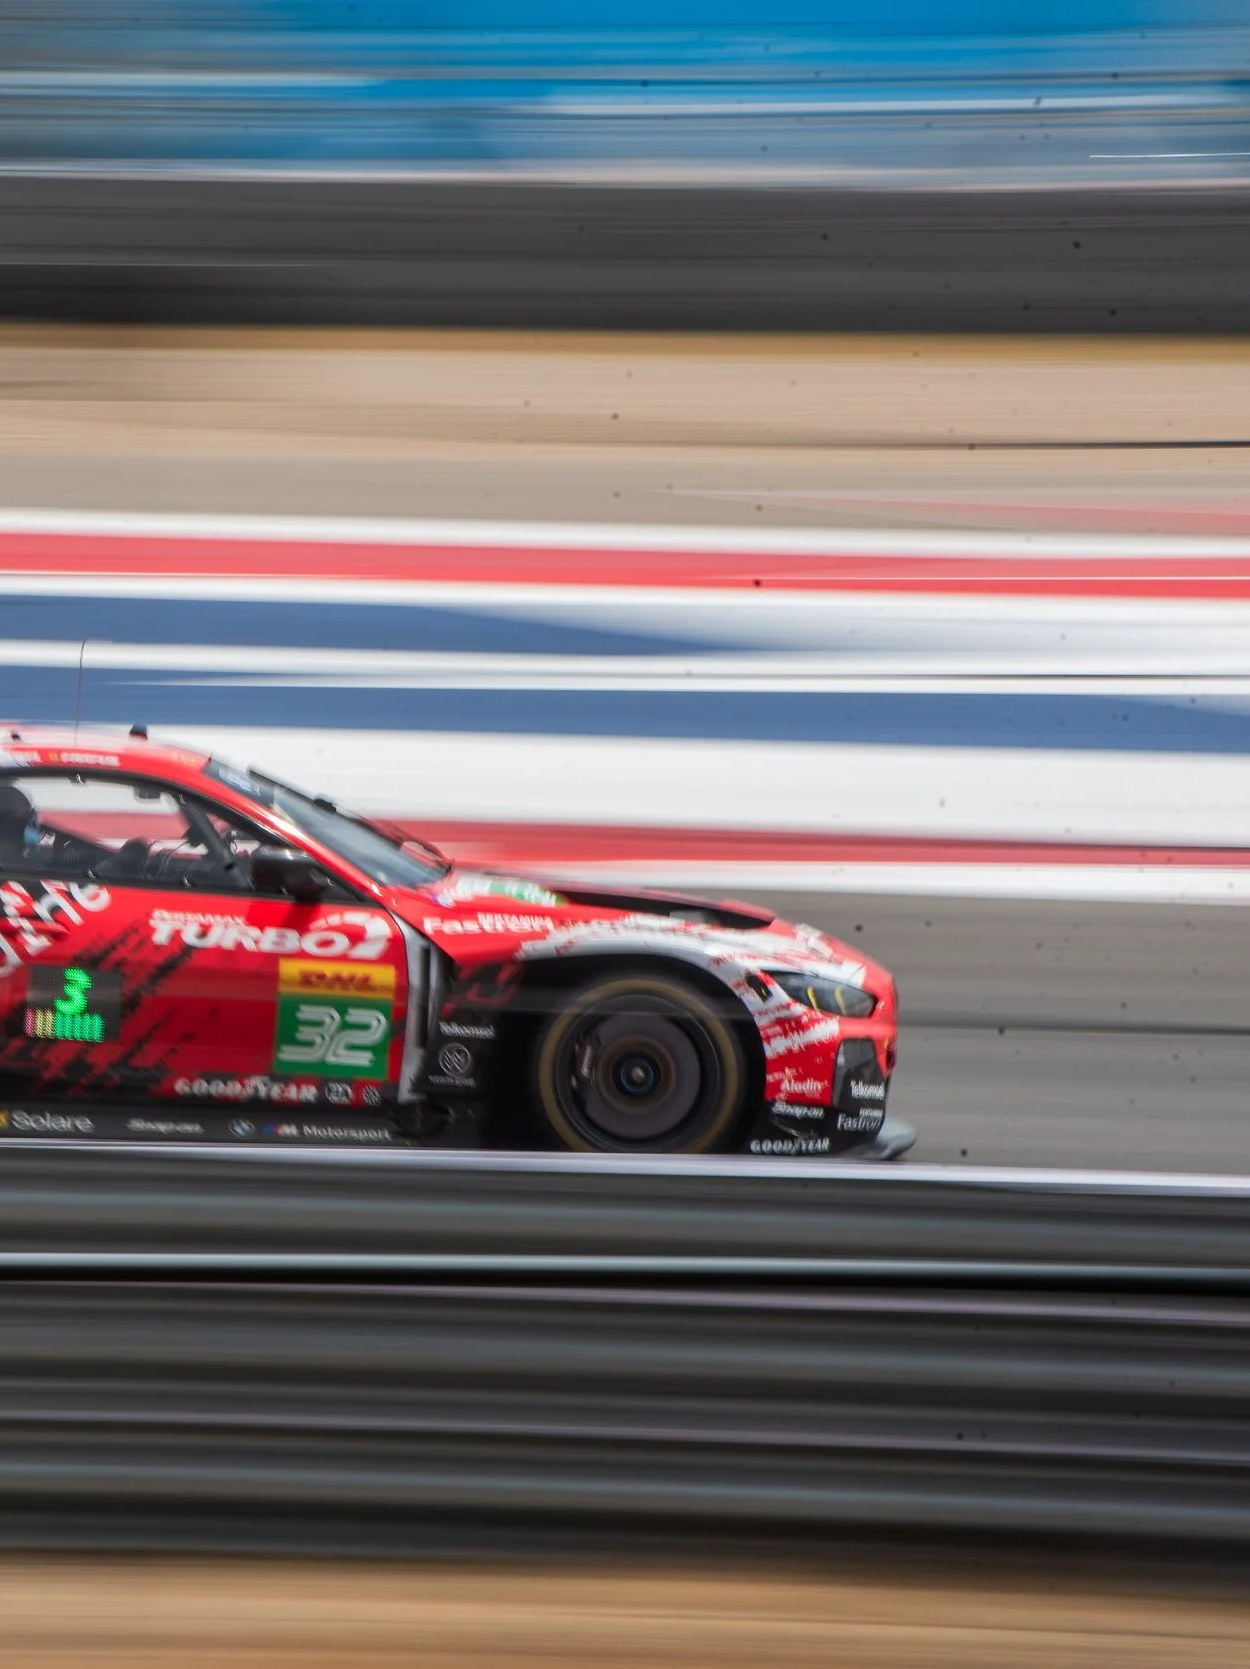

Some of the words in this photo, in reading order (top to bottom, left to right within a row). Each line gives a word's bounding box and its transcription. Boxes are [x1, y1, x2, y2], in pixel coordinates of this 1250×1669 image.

[53, 967, 92, 1015] 3
[277, 1004, 388, 1067] 32
[173, 1075, 318, 1104] GOODYEAR
[11, 1109, 96, 1133] Solare
[302, 1124, 393, 1142] Motorsport
[836, 1112, 881, 1133] Fastron
[750, 1137, 830, 1156] GOODYEAR
